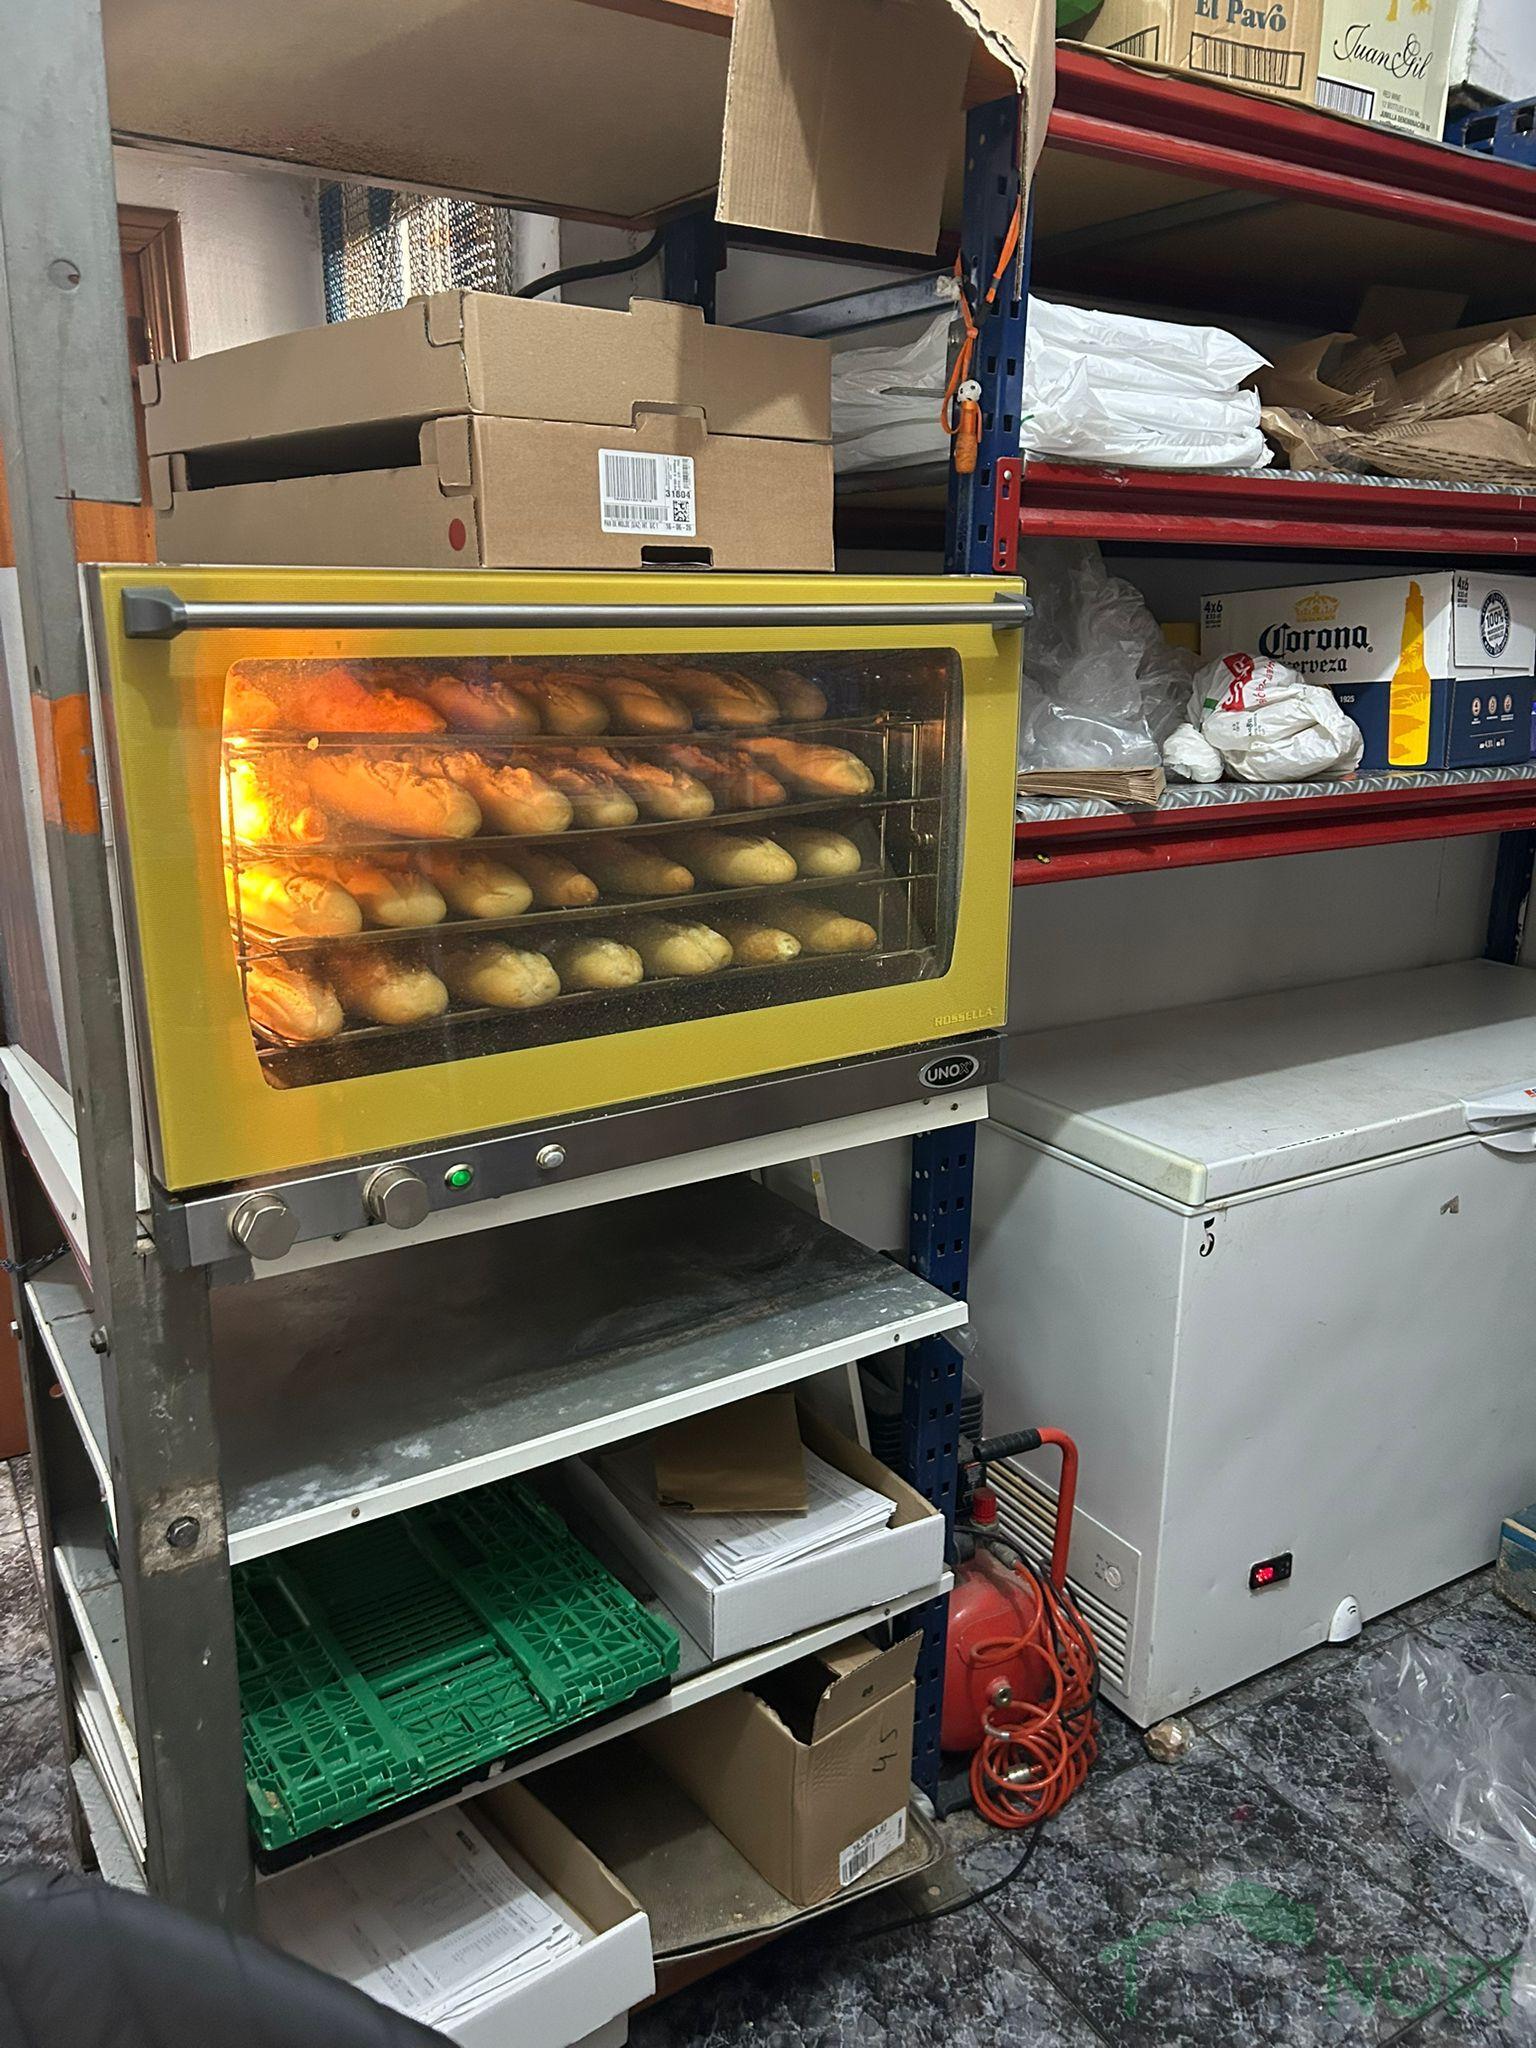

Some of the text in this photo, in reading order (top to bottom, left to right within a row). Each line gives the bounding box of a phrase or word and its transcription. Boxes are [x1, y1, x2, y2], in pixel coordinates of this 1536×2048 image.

[1226, 0, 1287, 33] Pavo
[1333, 24, 1433, 79] Juan Gil
[1204, 600, 1223, 613] 4x6
[1486, 610, 1504, 628] 100%
[1259, 622, 1370, 659] Corona
[1340, 695, 1355, 704] 1925
[934, 1007, 993, 1028] ROSSELLA
[927, 1060, 971, 1082] UNOX
[1199, 1216, 1216, 1257] 5
